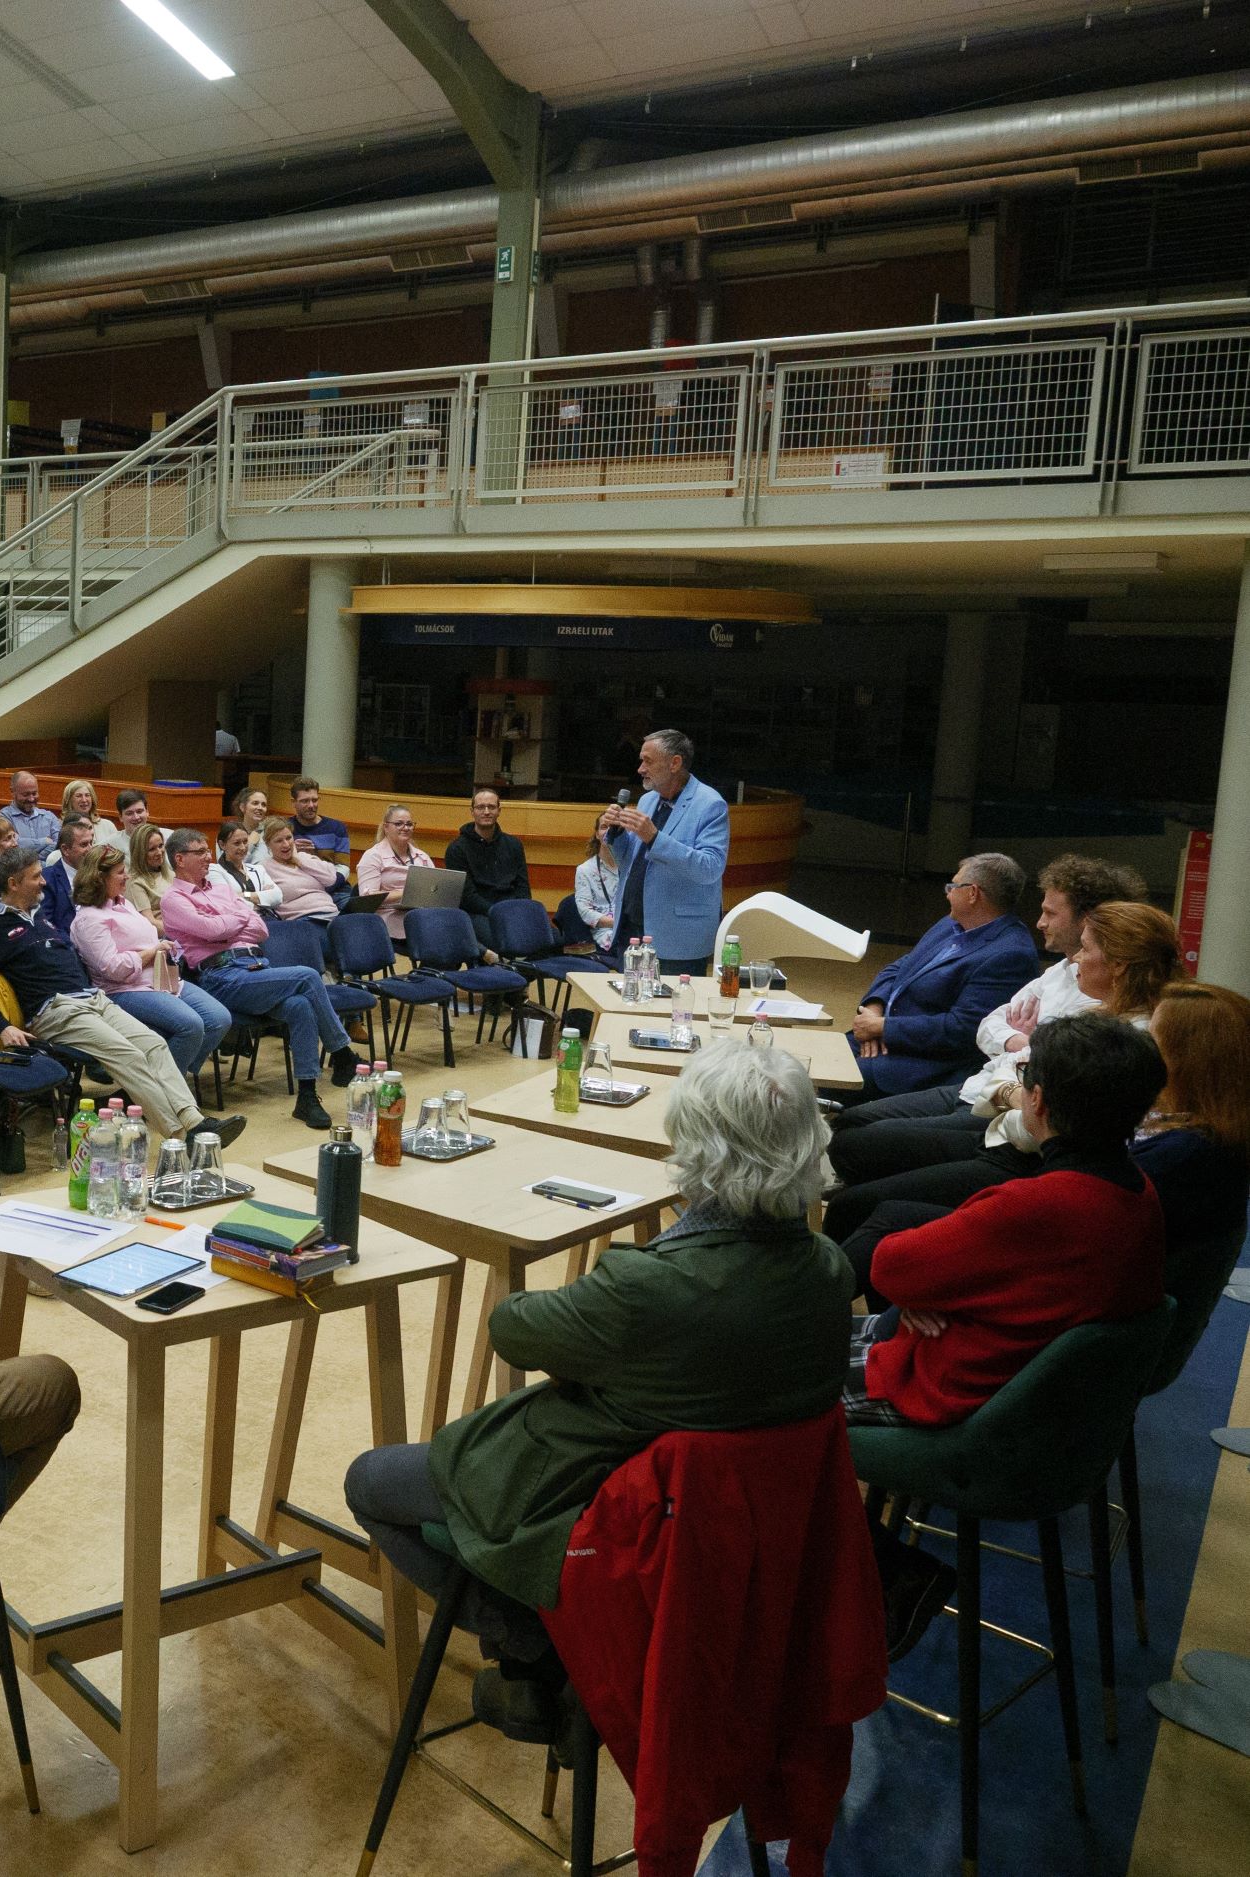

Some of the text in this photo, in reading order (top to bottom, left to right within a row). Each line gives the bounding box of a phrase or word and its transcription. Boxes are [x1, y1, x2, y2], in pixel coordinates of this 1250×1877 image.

[414, 623, 455, 633] TOLMÁCSOK
[557, 626, 614, 636] IZRAELI UTAK
